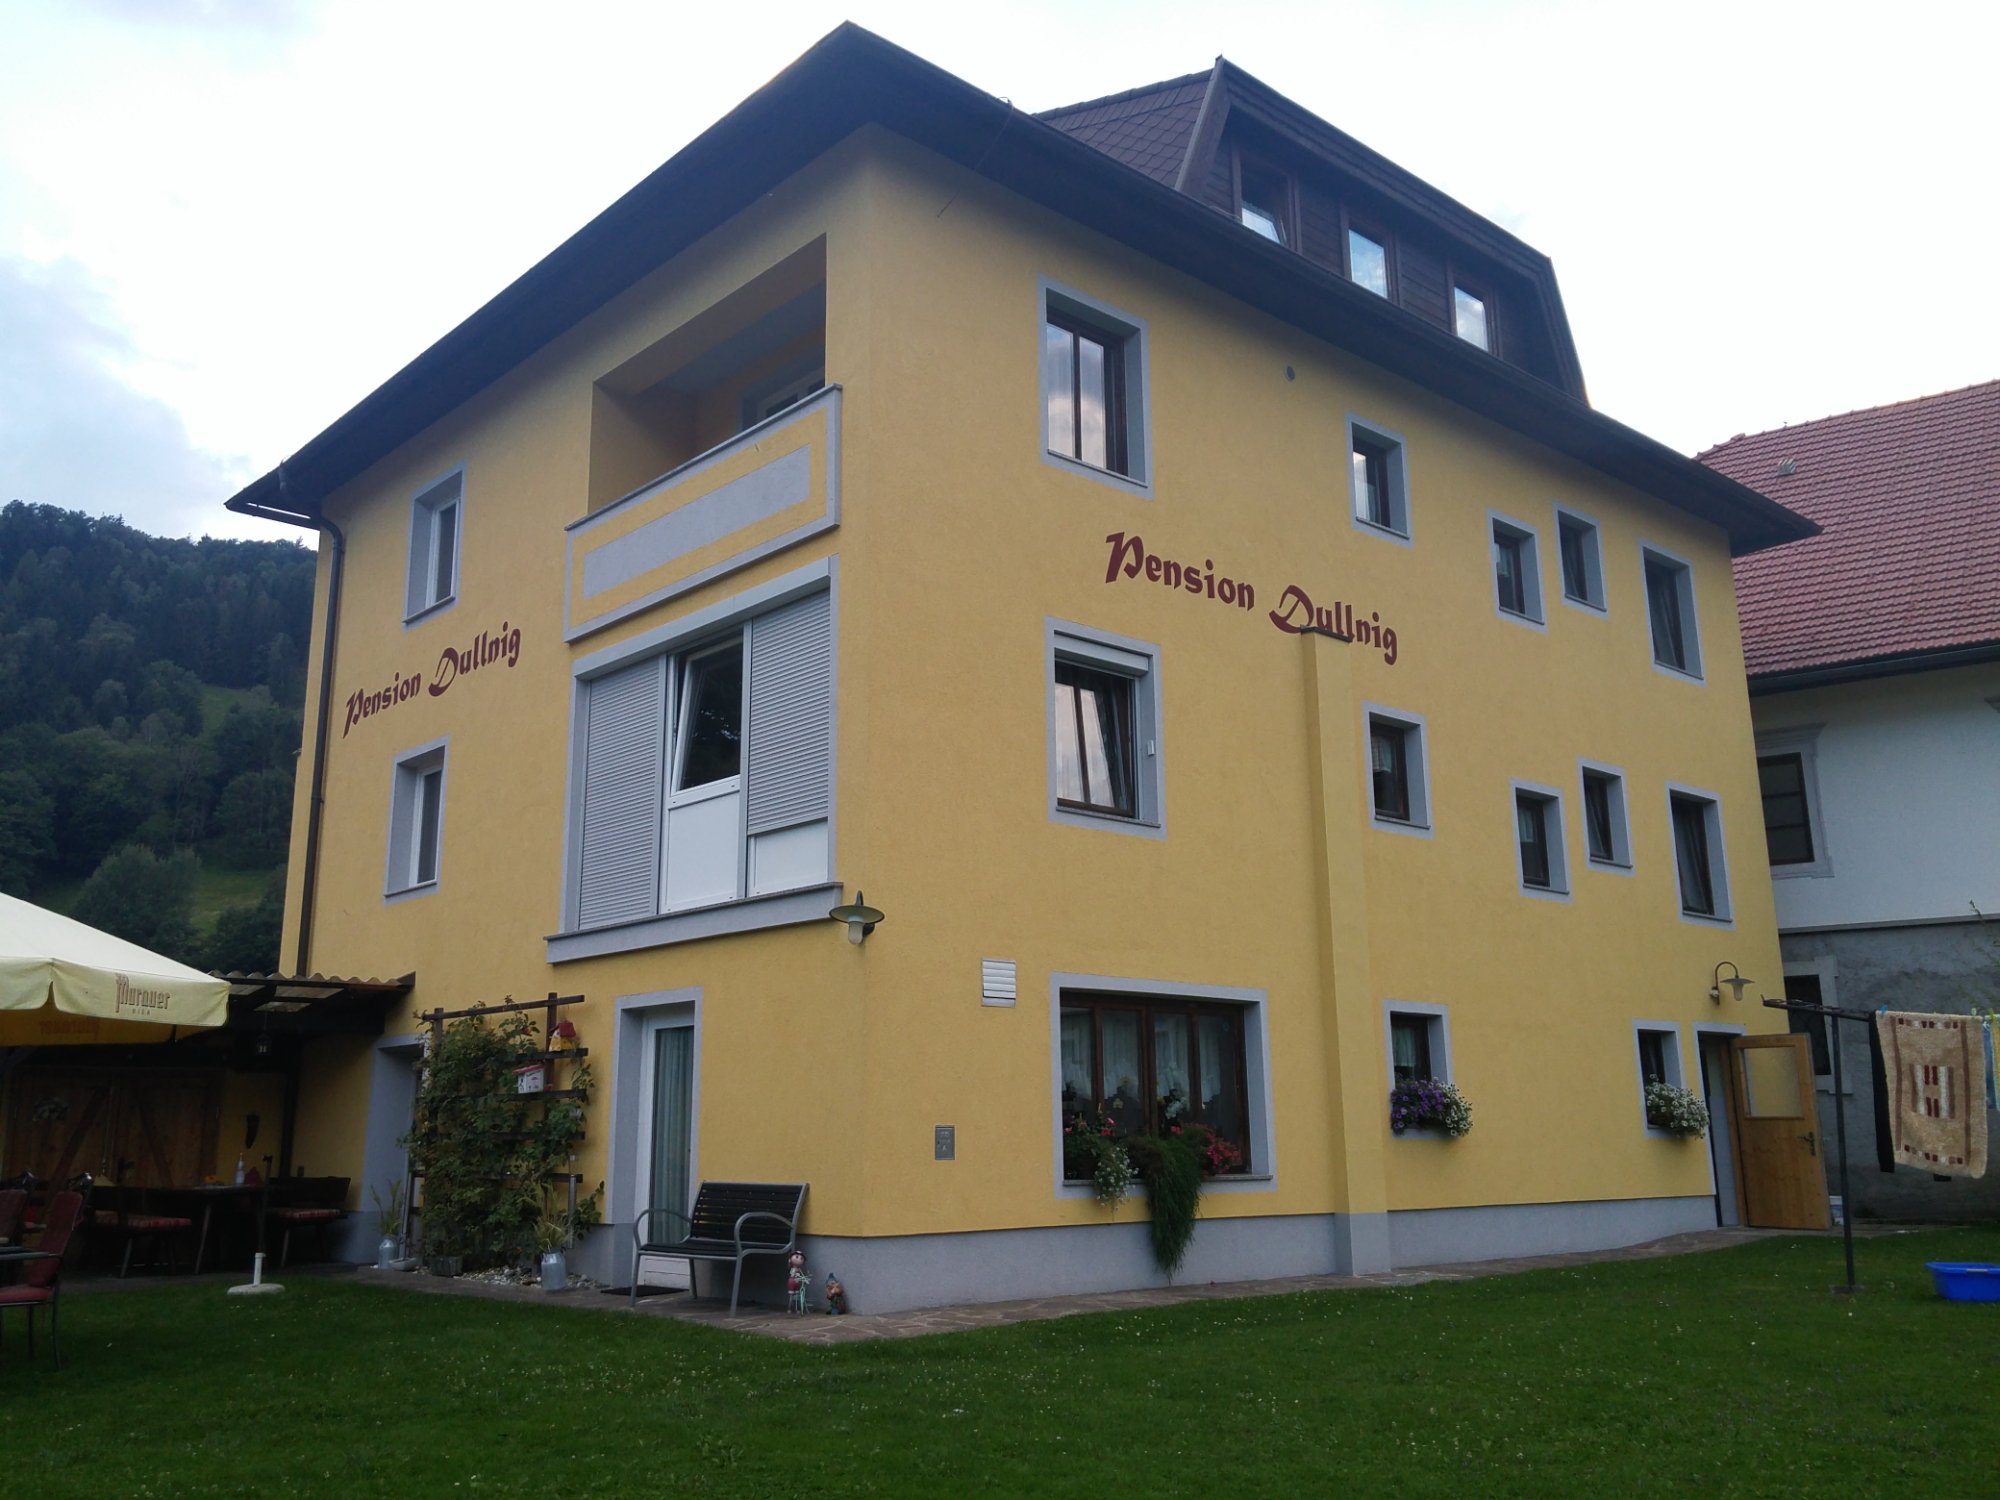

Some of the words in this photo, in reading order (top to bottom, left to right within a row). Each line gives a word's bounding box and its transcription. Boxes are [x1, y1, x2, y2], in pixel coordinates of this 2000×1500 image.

[1105, 531, 1255, 611] Pension
[1269, 585, 1398, 666] Dullnig
[342, 672, 422, 739] Pension
[428, 621, 521, 697] Dullnig
